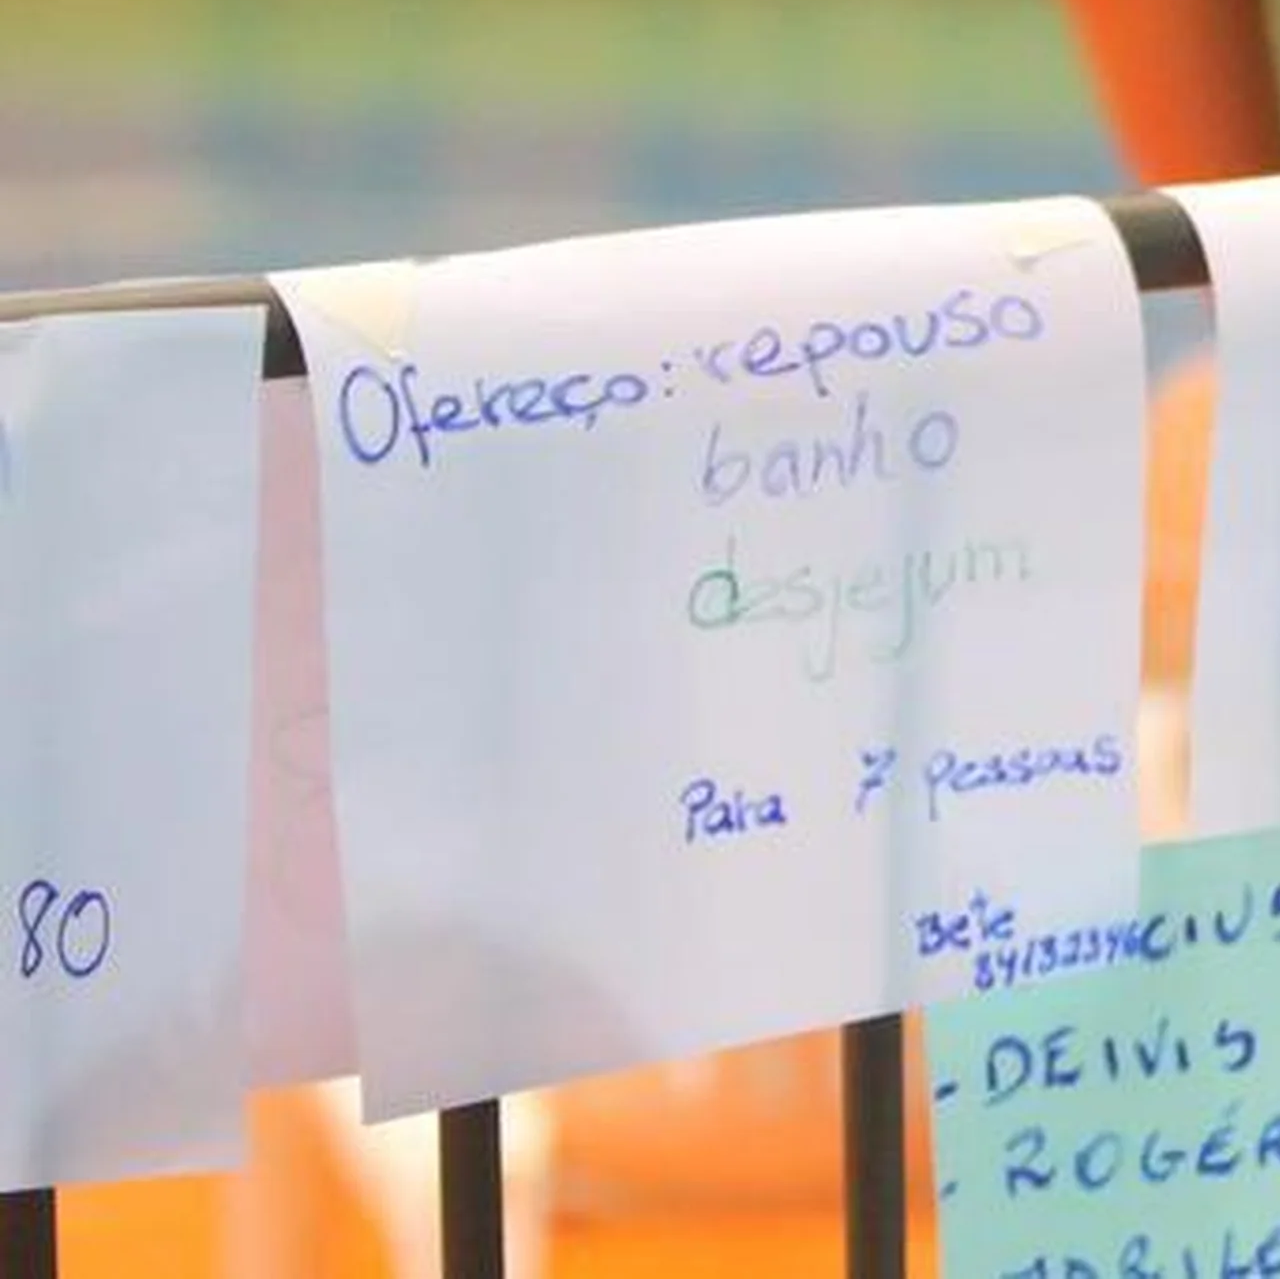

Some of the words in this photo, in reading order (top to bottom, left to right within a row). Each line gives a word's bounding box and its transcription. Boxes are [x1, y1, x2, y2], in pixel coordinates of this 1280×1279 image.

[695, 289, 1044, 398] repouso
[703, 389, 960, 507] banho
[688, 531, 1034, 683] desjejum
[680, 777, 788, 843] Para
[854, 745, 897, 817] 7
[17, 879, 109, 978] 80
[983, 1018, 1256, 1109] DEIVIS
